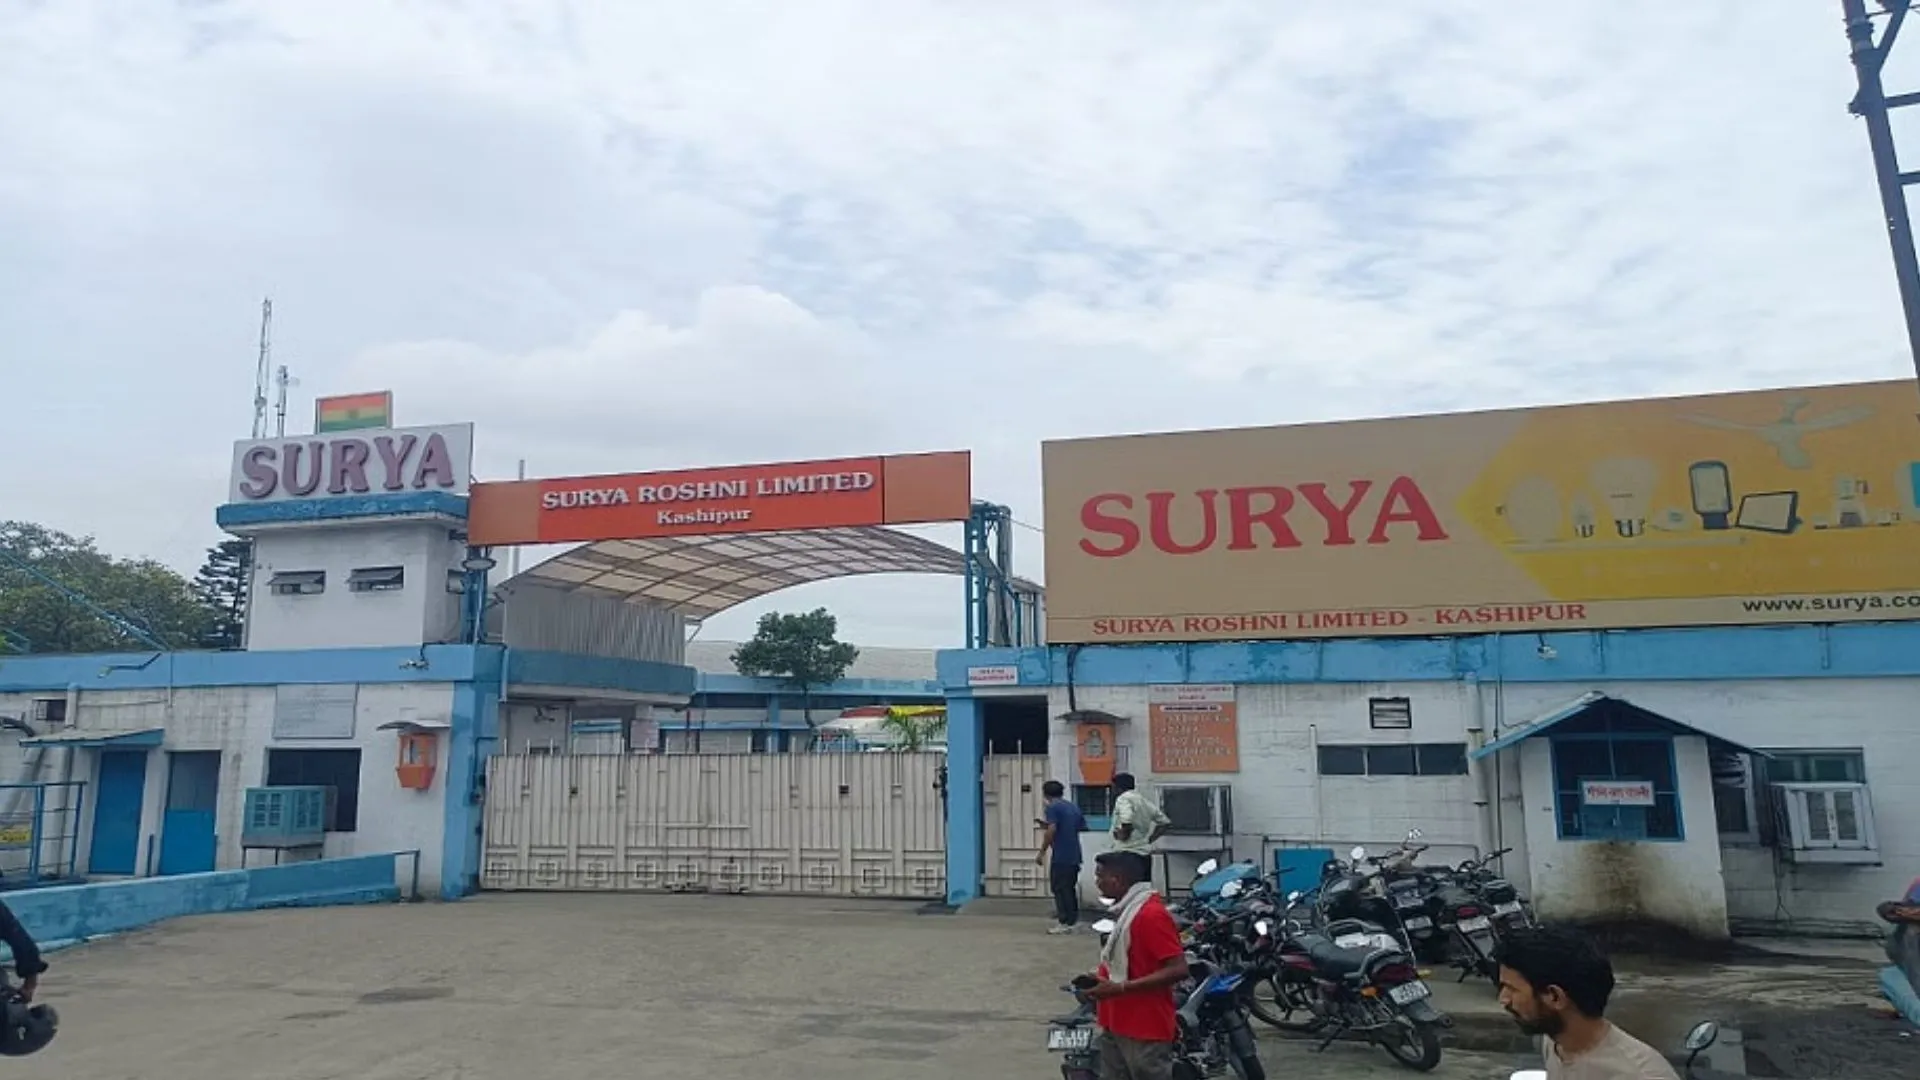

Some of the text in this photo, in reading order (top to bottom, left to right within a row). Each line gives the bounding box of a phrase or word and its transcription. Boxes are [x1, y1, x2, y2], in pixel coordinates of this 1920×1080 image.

[240, 432, 454, 498] SURYA
[542, 471, 874, 509] SURYA ROSHNI LIMITED
[656, 506, 752, 526] Kashipur
[1079, 475, 1449, 557] SURYA
[1093, 617, 1175, 636] SURYA
[1184, 614, 1289, 633] ROSHNI
[1297, 610, 1409, 630] LIMITED
[1435, 603, 1587, 625] KASHIPUR
[1742, 595, 1920, 612] www.surya.co
